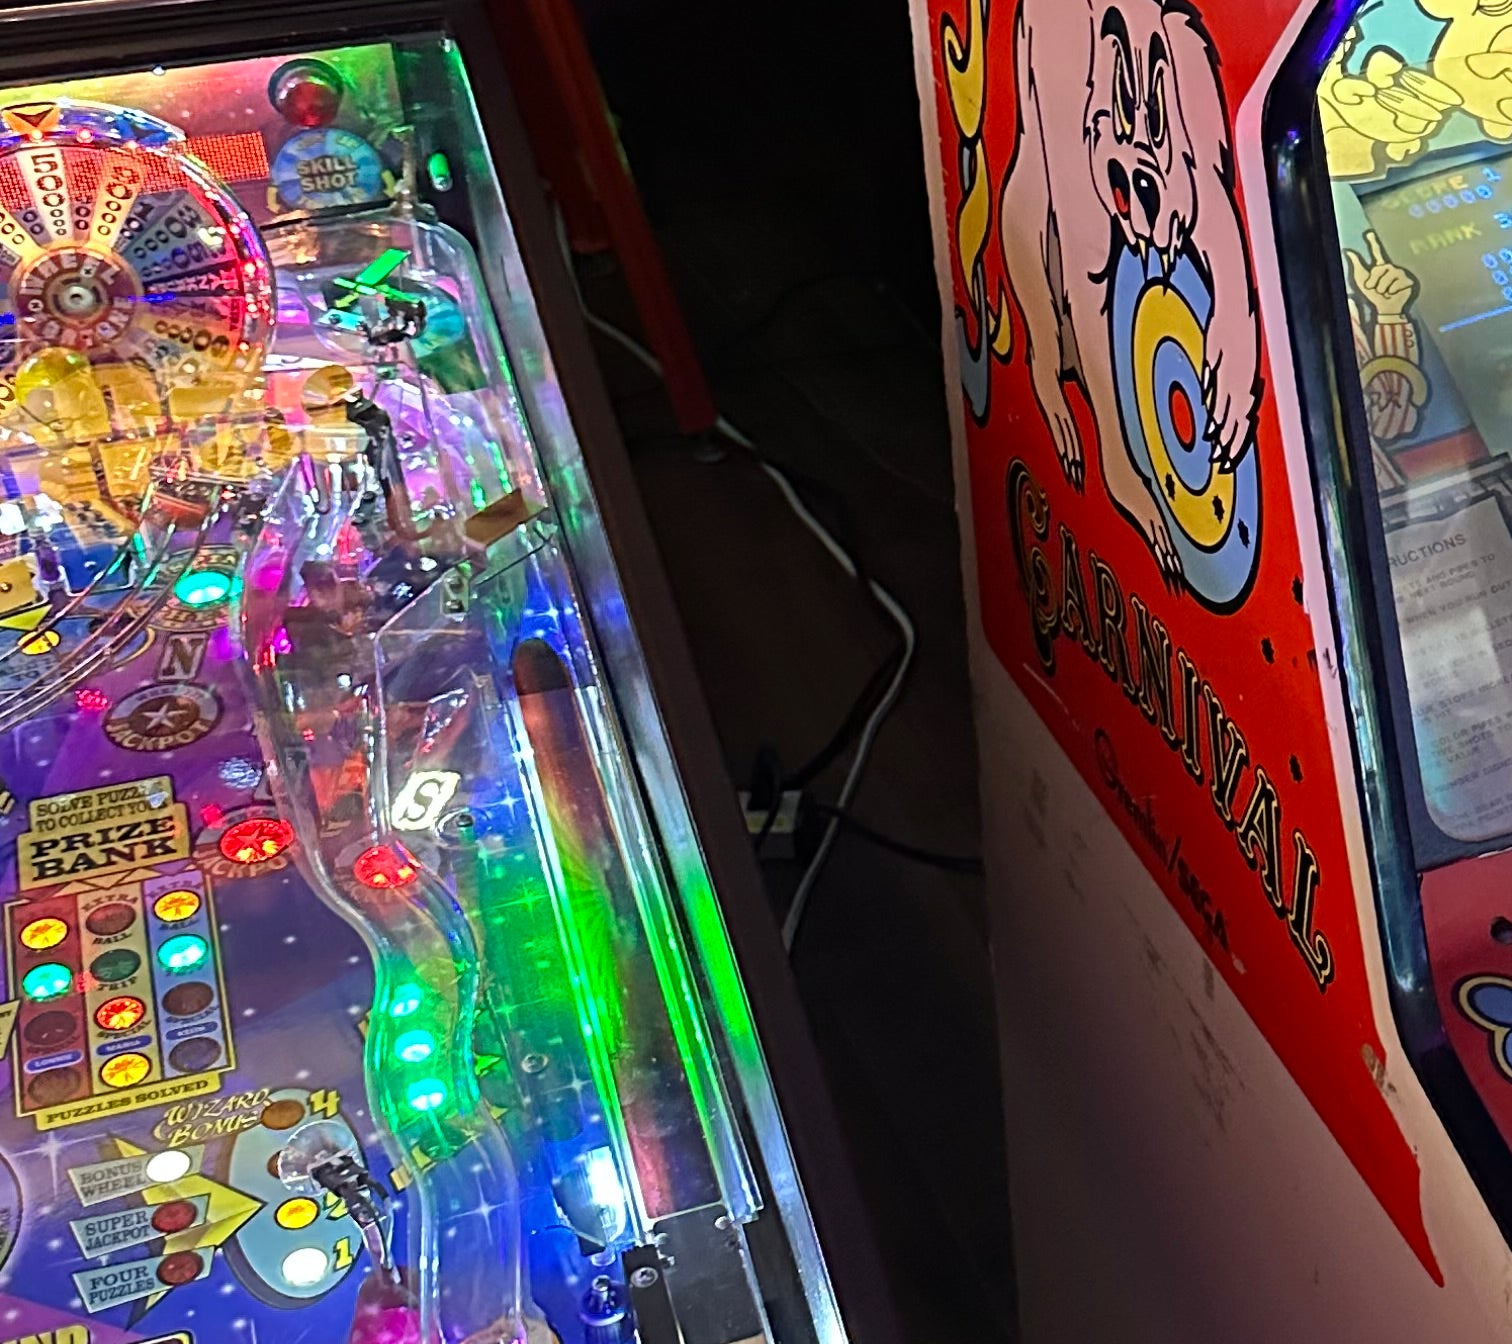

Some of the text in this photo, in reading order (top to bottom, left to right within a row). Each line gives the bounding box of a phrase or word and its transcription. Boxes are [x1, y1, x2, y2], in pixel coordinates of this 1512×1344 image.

[297, 157, 356, 175] SKILL
[300, 173, 357, 191] SHOT
[1482, 166, 1501, 183] 1
[105, 713, 211, 751] JACKPOT
[1006, 457, 1336, 995] CARNIVAL
[36, 780, 163, 818] SOLVE PUZZ
[36, 797, 168, 833] TO COLLECT YO
[404, 777, 446, 823] S
[30, 815, 176, 859] PRIZE
[31, 835, 178, 882] BANK
[46, 1079, 209, 1124] PUZZLES SOLVED
[163, 1088, 271, 1125] WIZARD
[308, 1089, 341, 1118] 4
[154, 1112, 261, 1149] BONUS
[80, 1159, 143, 1184] BONUS
[80, 1174, 147, 1199] WHEEL
[85, 1209, 149, 1237] SUPER
[85, 1225, 151, 1252] JACKPOT
[333, 1236, 354, 1270] 1
[88, 1277, 156, 1306] PUZZLES
[89, 1266, 149, 1292] FOUR
